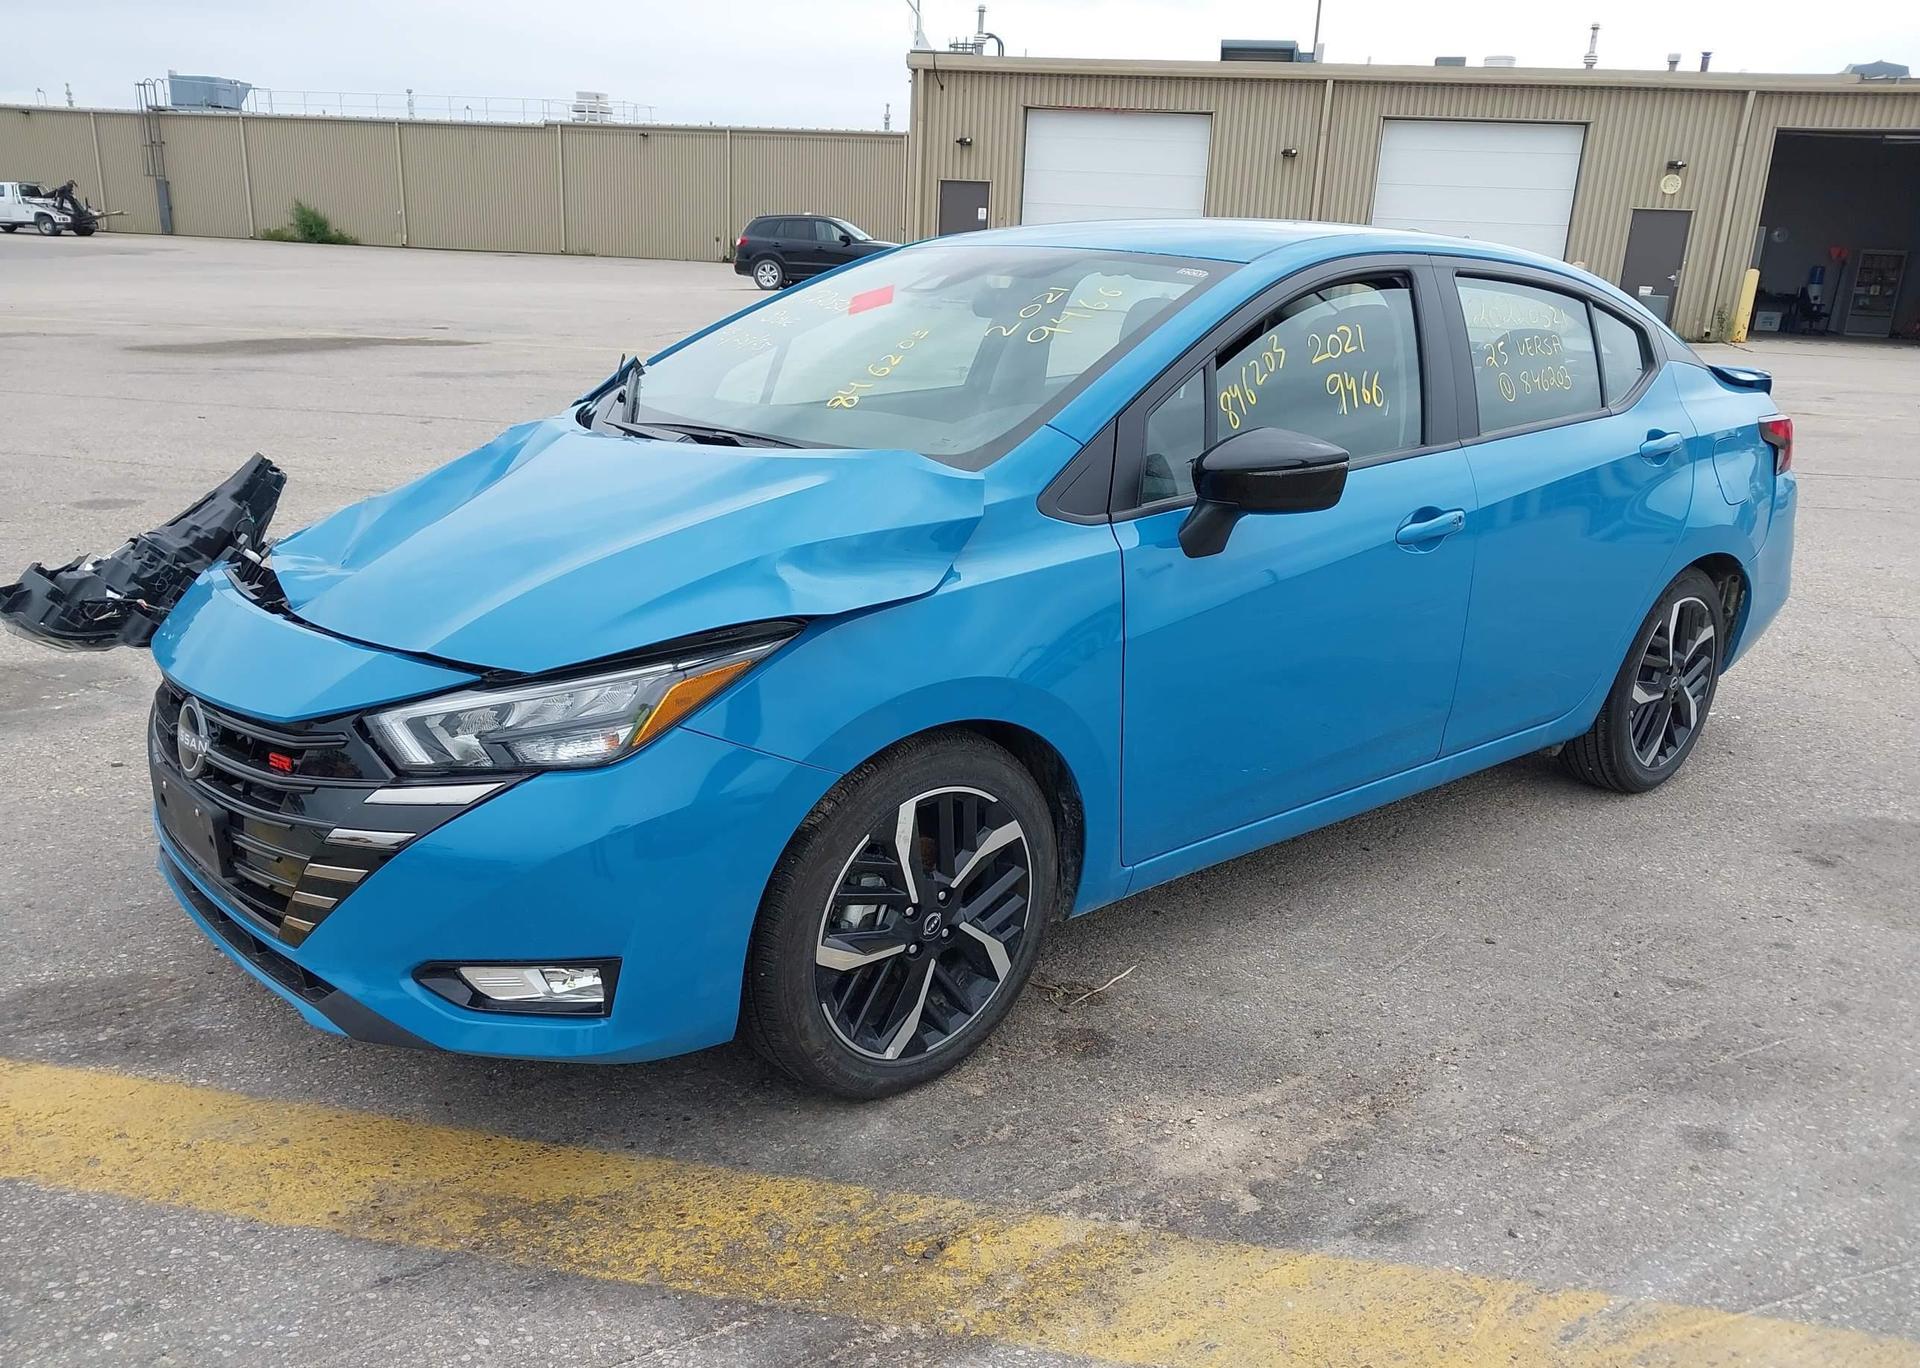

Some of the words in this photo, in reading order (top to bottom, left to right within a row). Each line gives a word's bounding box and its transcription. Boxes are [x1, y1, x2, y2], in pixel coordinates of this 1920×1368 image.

[984, 286, 1070, 336] 2021
[1026, 286, 1123, 343] 9466
[1307, 323, 1365, 364] 2021
[1516, 335, 1563, 357] VERSA
[1219, 334, 1286, 430] 846203
[1326, 370, 1384, 415] 9466
[1519, 365, 1573, 394] 846203
[268, 752, 292, 772] SR
